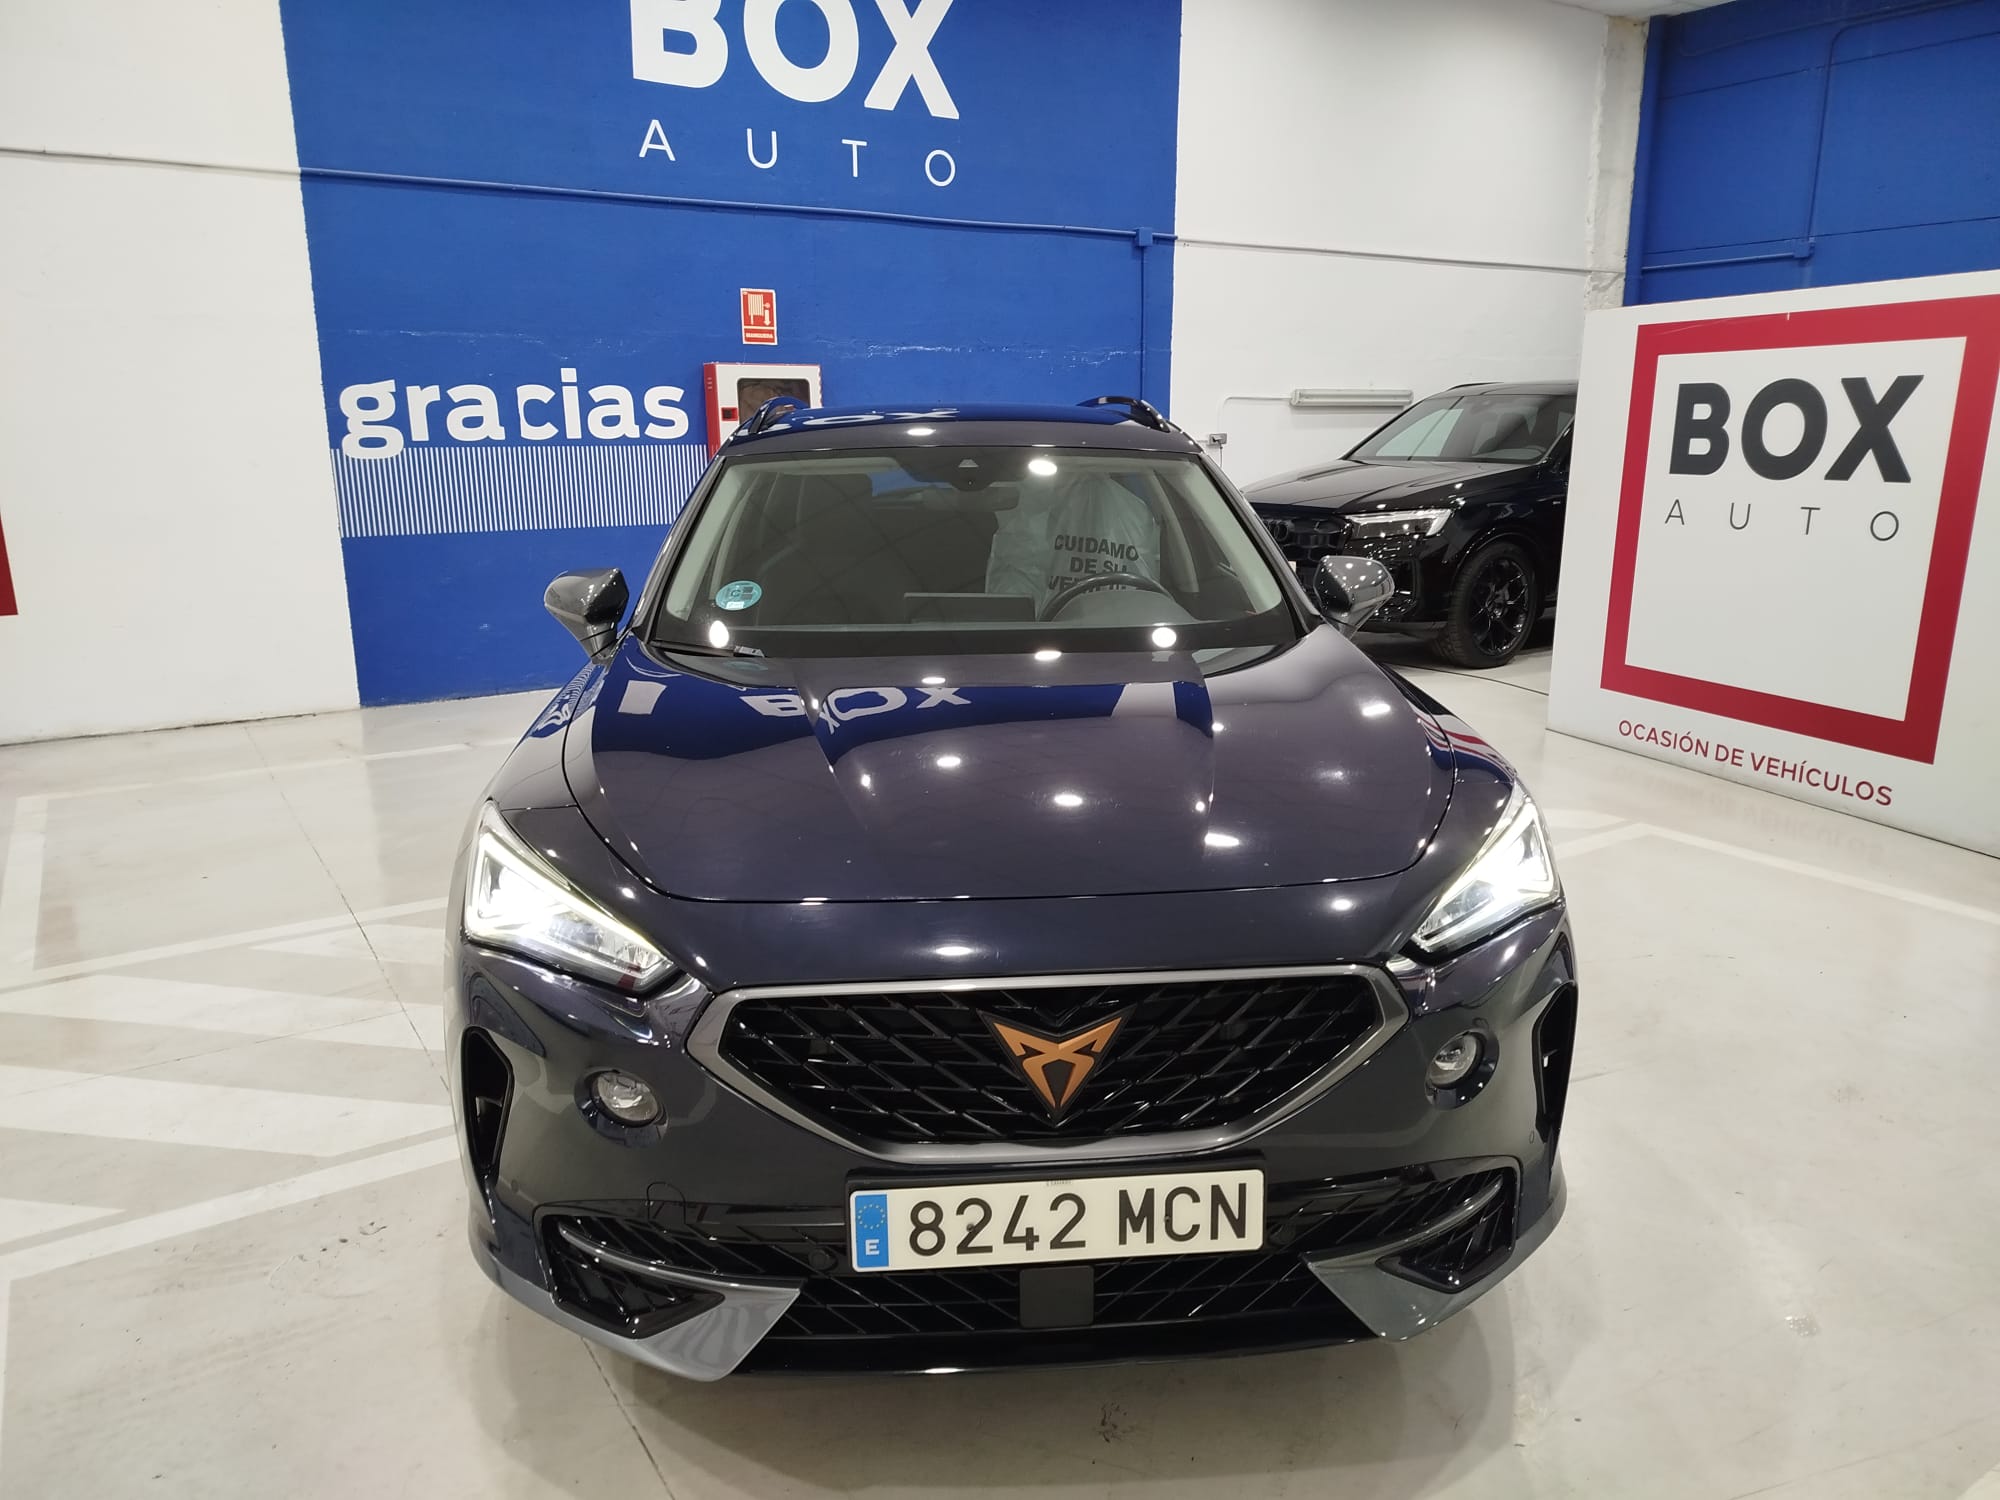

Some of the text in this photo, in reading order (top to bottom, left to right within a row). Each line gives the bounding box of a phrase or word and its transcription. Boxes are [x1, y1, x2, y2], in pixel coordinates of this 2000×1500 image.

[630, 0, 960, 120] BOX
[639, 119, 957, 187] AUTO
[339, 367, 689, 460] gracias
[1669, 374, 1924, 483] BOX
[1664, 499, 1900, 541] AUTO
[1070, 556, 1097, 574] DE
[1618, 720, 1893, 807] OCASIÓN DE VEHÍCULOS
[865, 1238, 880, 1255] E
[909, 1182, 1247, 1257] 8242 MCN
